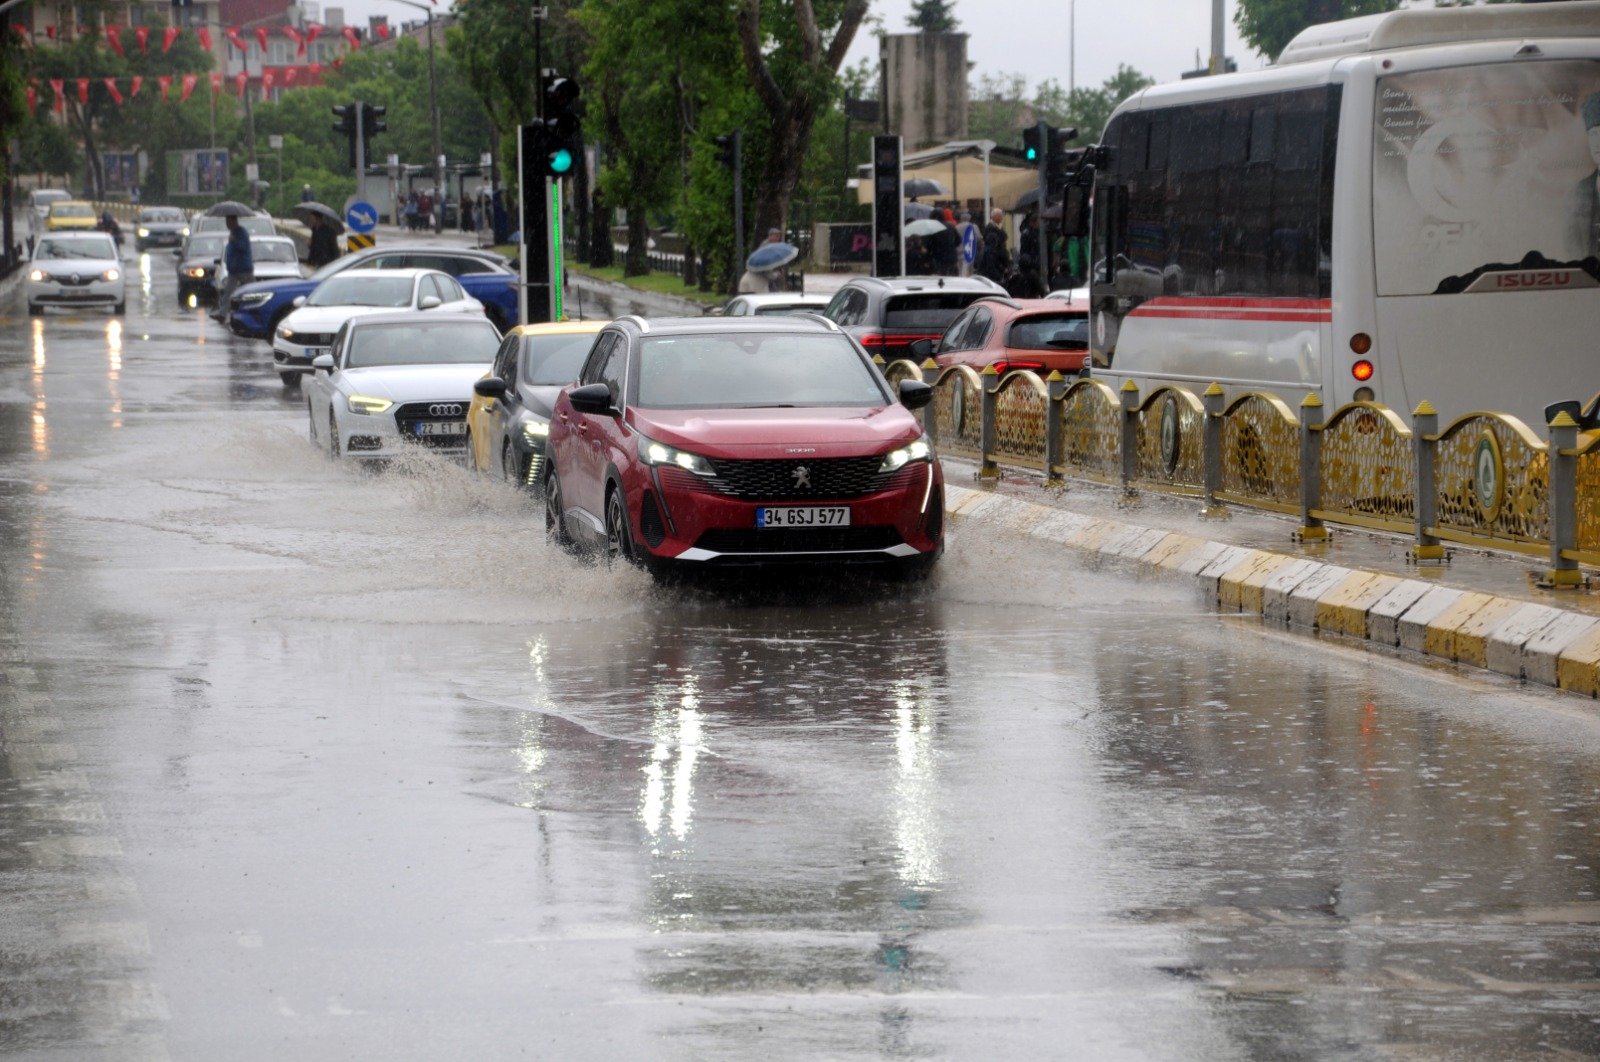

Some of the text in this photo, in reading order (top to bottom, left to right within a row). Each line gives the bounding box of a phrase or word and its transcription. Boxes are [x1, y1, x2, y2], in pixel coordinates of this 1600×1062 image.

[1383, 88, 1405, 98] Beni
[1384, 117, 1414, 127] Benim
[1497, 272, 1570, 287] ISUZU
[422, 423, 433, 433] 22
[441, 423, 453, 433] ET
[765, 508, 845, 524] 34 GSJ 577
